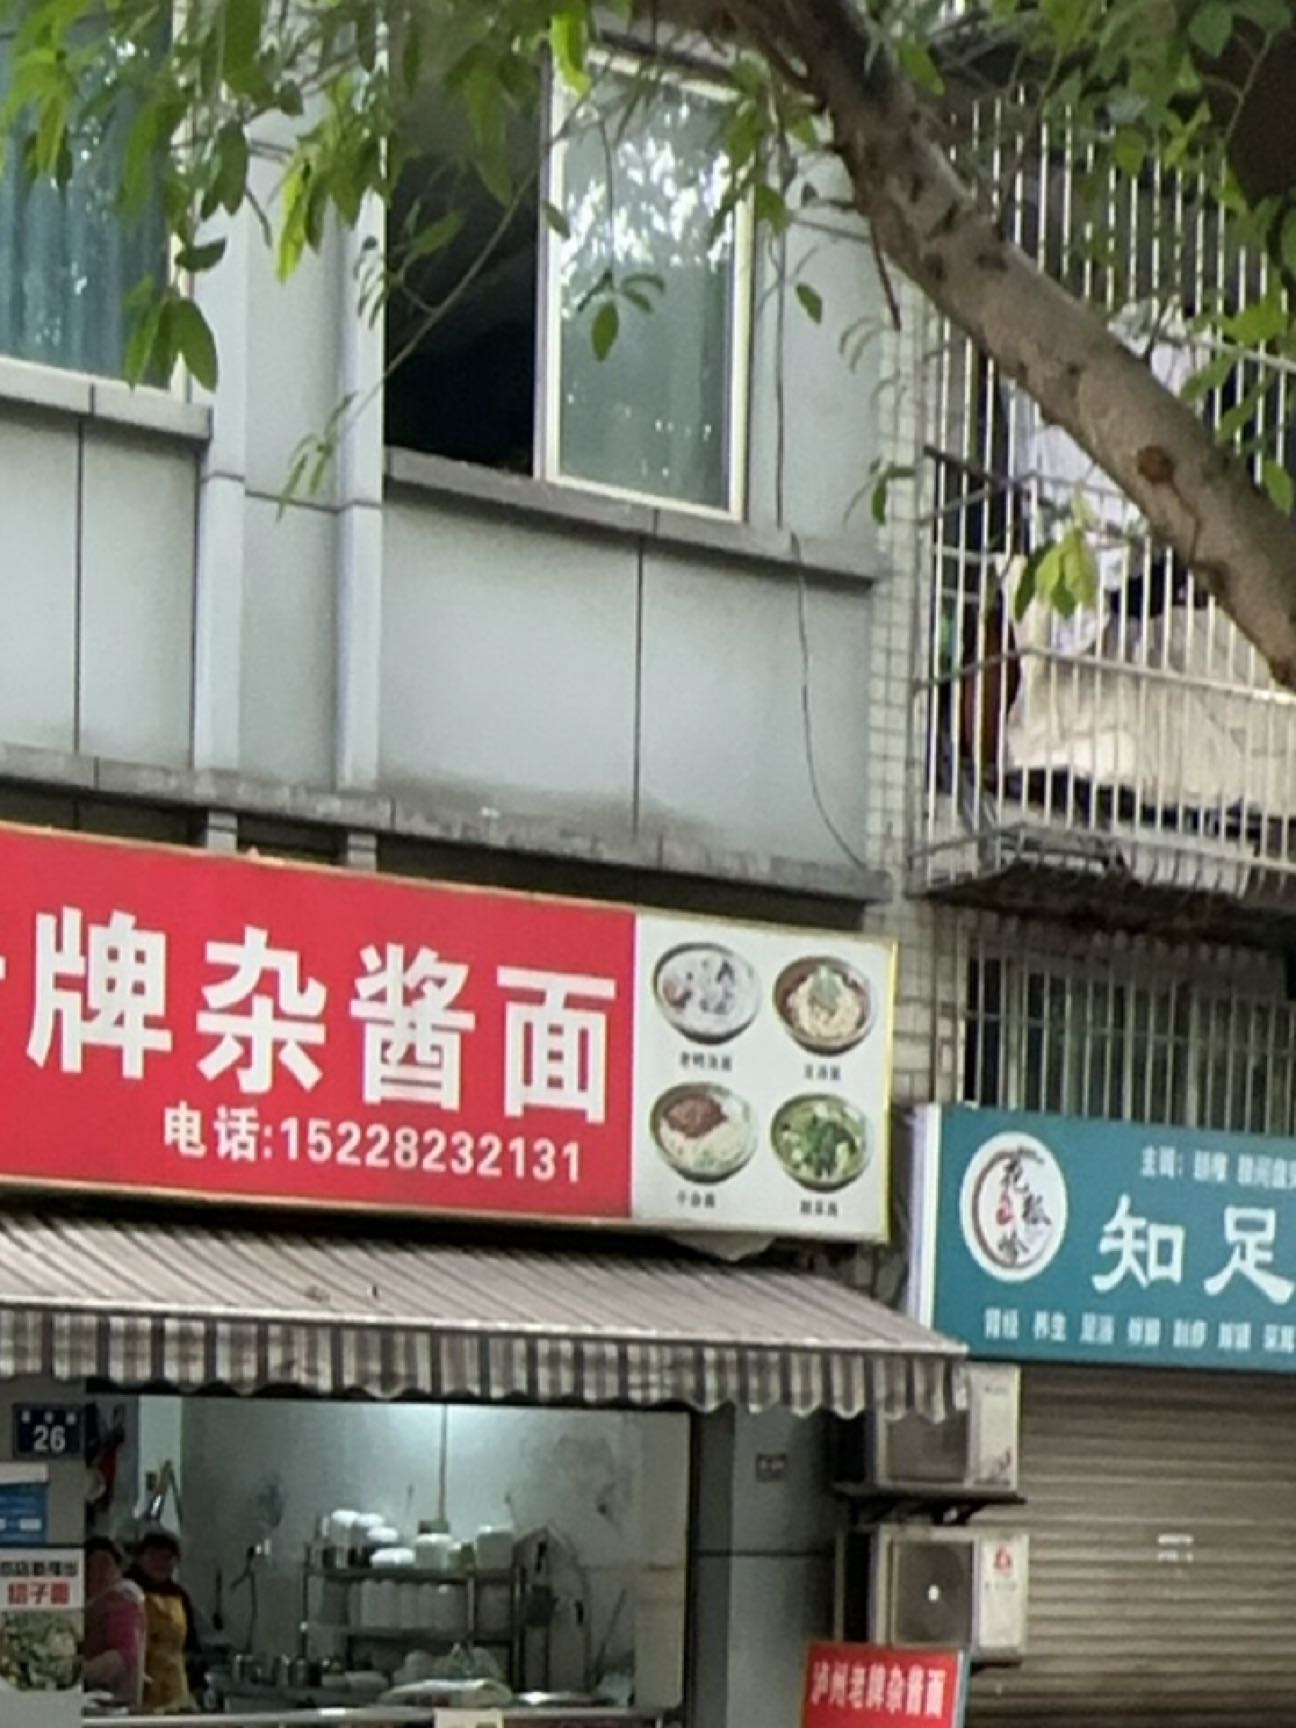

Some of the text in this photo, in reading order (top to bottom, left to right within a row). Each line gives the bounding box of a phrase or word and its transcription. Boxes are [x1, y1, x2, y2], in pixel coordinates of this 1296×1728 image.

[163, 1099, 582, 1184] 电话:15228232131
[1092, 1193, 1295, 1304] 知足
[33, 1425, 66, 1452] 26
